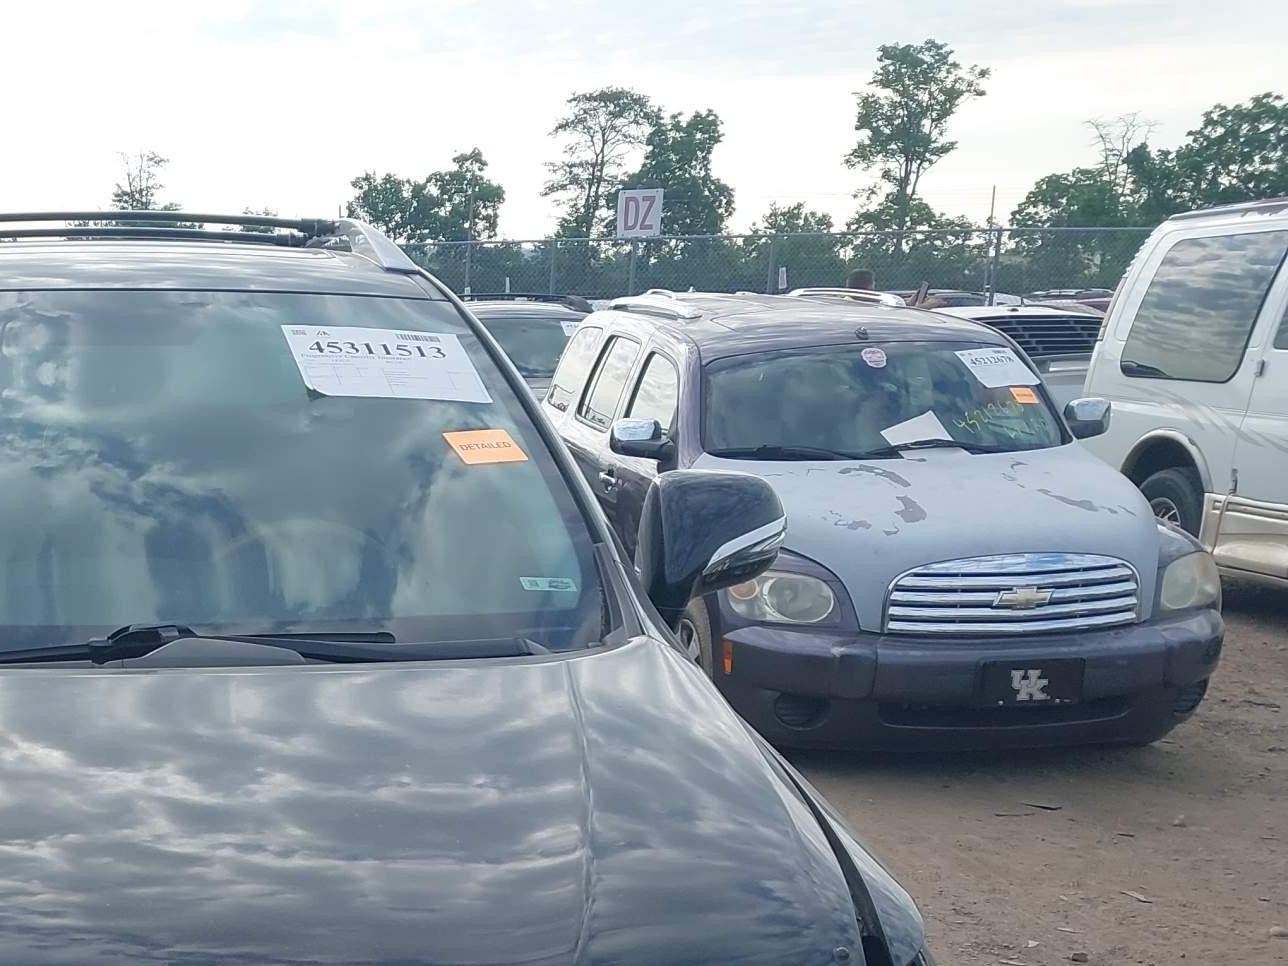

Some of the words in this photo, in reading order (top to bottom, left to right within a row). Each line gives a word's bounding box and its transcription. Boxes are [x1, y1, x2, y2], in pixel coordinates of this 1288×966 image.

[624, 196, 656, 230] DZ
[309, 340, 447, 360] 45311513
[458, 441, 512, 452] DETAILED
[1010, 668, 1050, 702] UK
